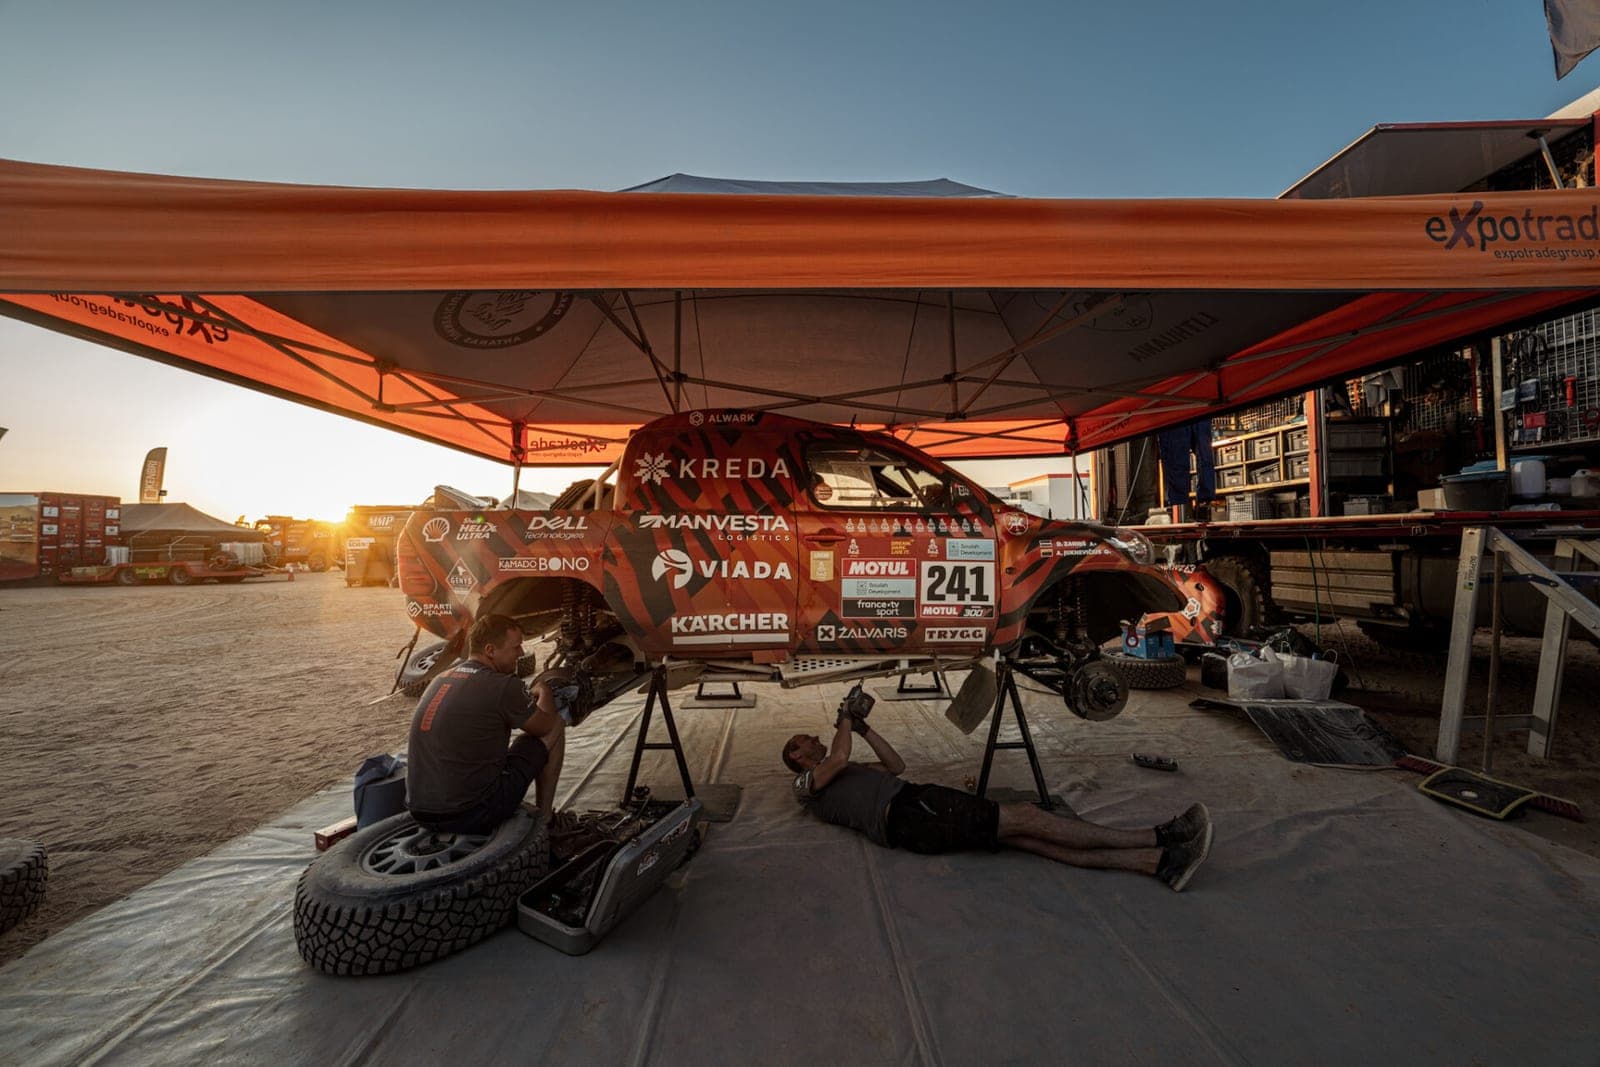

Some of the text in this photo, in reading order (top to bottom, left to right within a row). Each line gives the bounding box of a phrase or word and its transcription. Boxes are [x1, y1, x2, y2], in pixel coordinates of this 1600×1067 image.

[708, 413, 756, 423] ALWARK
[679, 458, 791, 479] KREDA
[459, 522, 498, 533] HELIX
[528, 516, 588, 530] DELL
[654, 515, 789, 531] MANVESTA
[456, 532, 490, 541] ULTRA
[524, 532, 585, 541] Technologies
[499, 557, 590, 571] KAMADO BONO
[699, 560, 792, 580] VIADA
[849, 562, 909, 575] MOTUL
[927, 565, 989, 602] 241
[423, 603, 452, 611] SPARTI
[876, 607, 900, 618] sport
[923, 606, 958, 615] MOTUL
[671, 613, 789, 633] KÄRCHER
[926, 629, 984, 640] TRYGG
